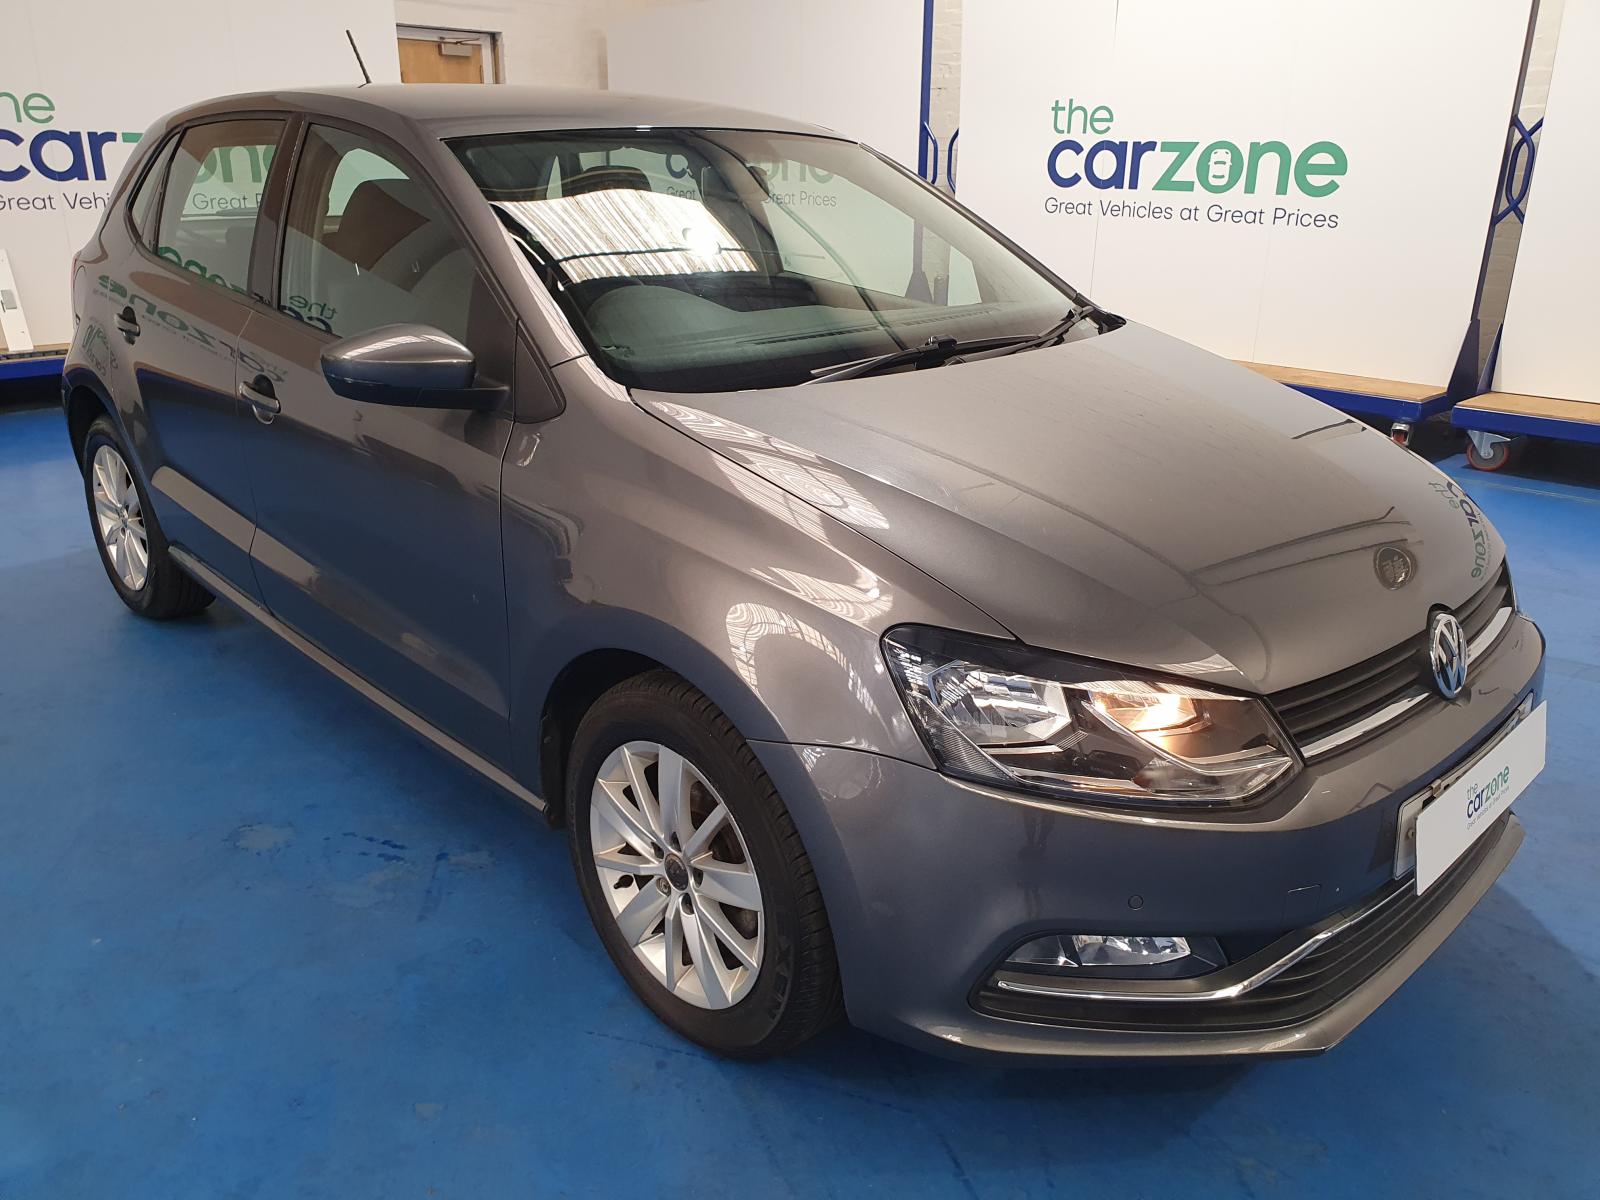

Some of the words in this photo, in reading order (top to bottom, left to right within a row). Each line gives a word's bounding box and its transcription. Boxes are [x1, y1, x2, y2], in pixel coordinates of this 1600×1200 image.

[1051, 98, 1114, 135] the
[1047, 139, 1348, 197] carzone
[192, 192, 248, 210] Great
[799, 190, 837, 207] Prices
[1044, 197, 1093, 216] Great
[1099, 200, 1173, 220] Vehicles
[1179, 207, 1199, 222] at
[1207, 204, 1265, 225] Great
[1273, 208, 1339, 229] Prices
[1467, 766, 1510, 818] carzone
